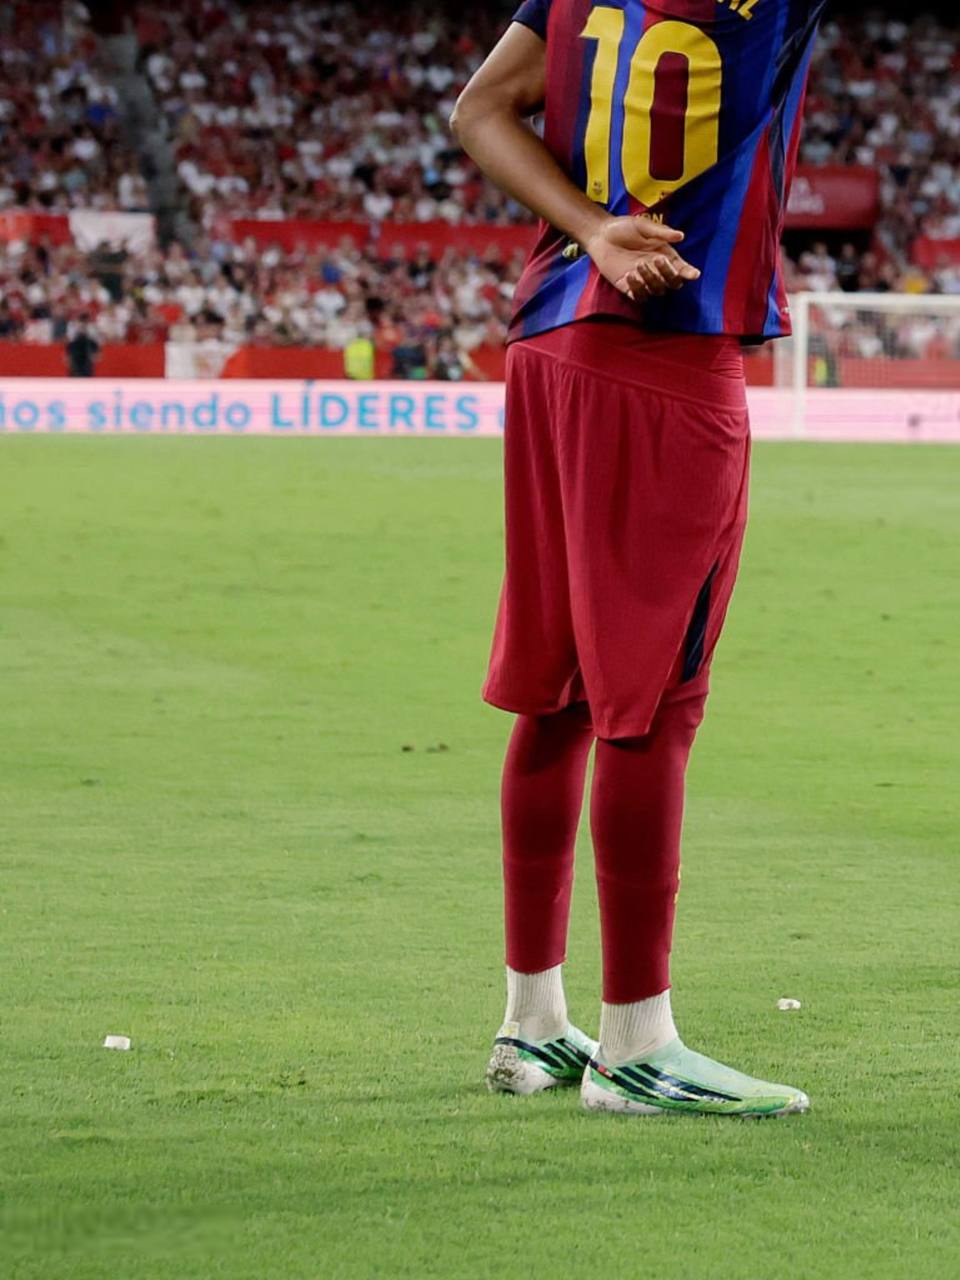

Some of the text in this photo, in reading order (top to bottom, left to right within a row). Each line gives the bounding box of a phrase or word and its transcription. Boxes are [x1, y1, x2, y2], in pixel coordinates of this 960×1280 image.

[579, 6, 722, 208] 10
[88, 388, 252, 431] siendo
[271, 381, 480, 431] LÍDERES
